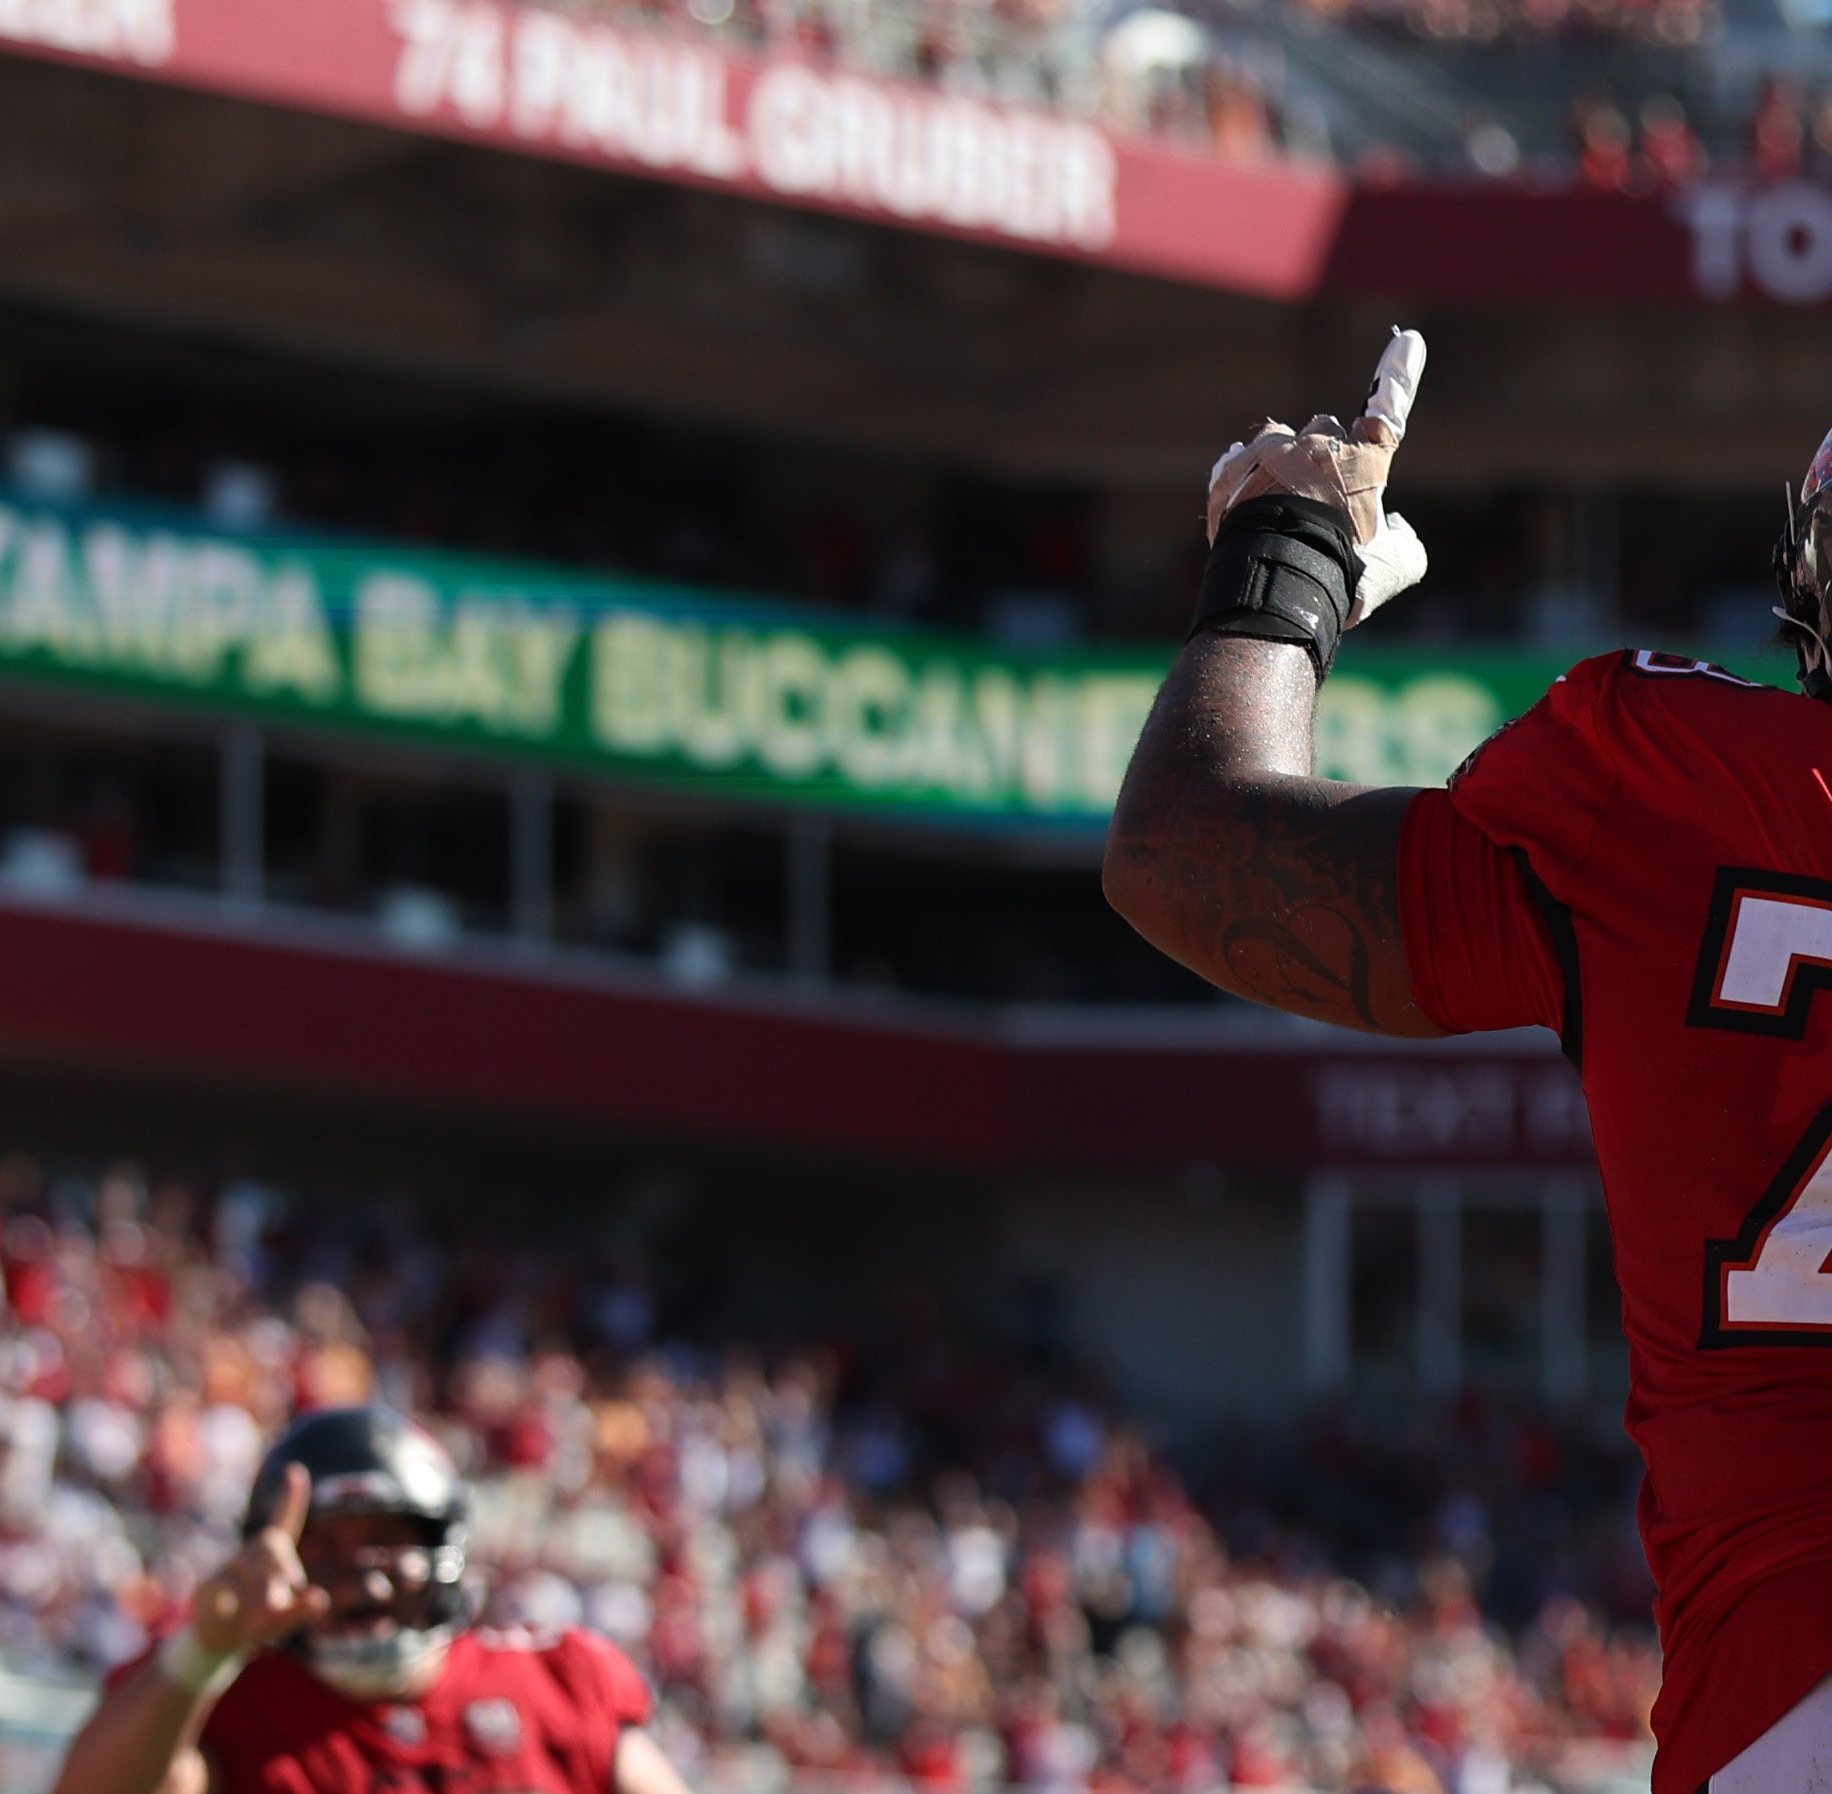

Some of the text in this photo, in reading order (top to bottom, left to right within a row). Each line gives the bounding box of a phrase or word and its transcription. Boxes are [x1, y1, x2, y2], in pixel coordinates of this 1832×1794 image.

[514, 6, 743, 174] PAUL
[753, 68, 1113, 247] GRUBER
[356, 568, 581, 736] BAY
